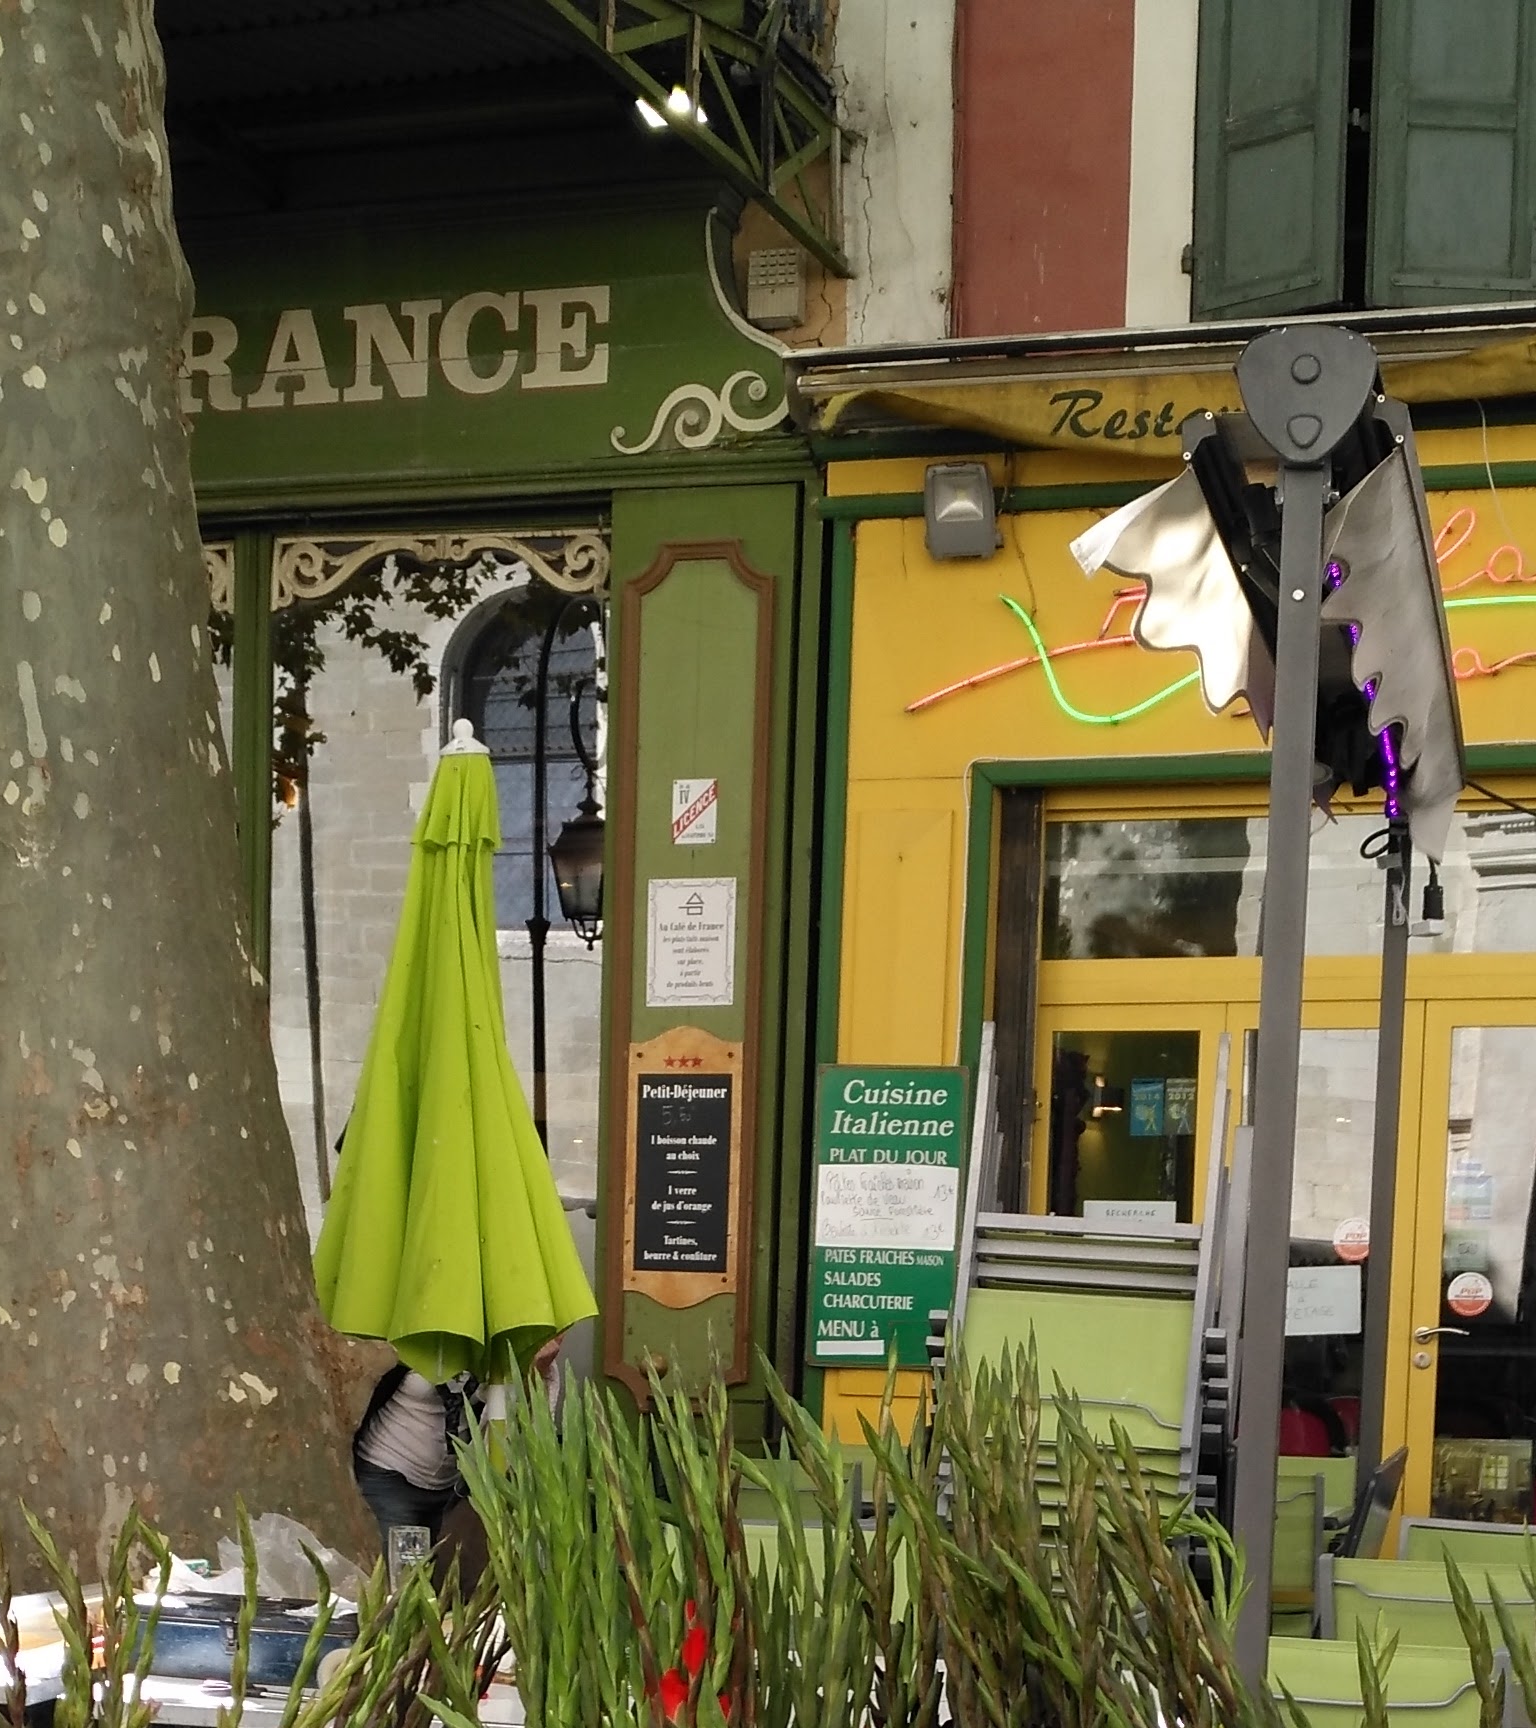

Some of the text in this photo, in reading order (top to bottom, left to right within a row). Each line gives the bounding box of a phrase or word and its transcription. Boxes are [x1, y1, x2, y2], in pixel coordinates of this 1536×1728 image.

[674, 785, 716, 838] LICENCE
[642, 1084, 728, 1102] Petit-Déjeuner
[843, 1079, 949, 1106] Cuisine
[830, 1110, 955, 1137] Italienne
[656, 1134, 687, 1145] boisson
[687, 1134, 718, 1146] chaude
[666, 1150, 700, 1162] au choix
[829, 1148, 948, 1166] PLAT DU JOUR
[674, 1186, 697, 1196] verre
[651, 1200, 713, 1213] de jus d'orange
[643, 1250, 718, 1262] beurre & confiture
[824, 1250, 944, 1267] PATES FRAICHES MAISON
[824, 1272, 882, 1287] SALADES
[823, 1294, 914, 1311] CHARCUTERIE
[817, 1319, 880, 1339] MENU à
